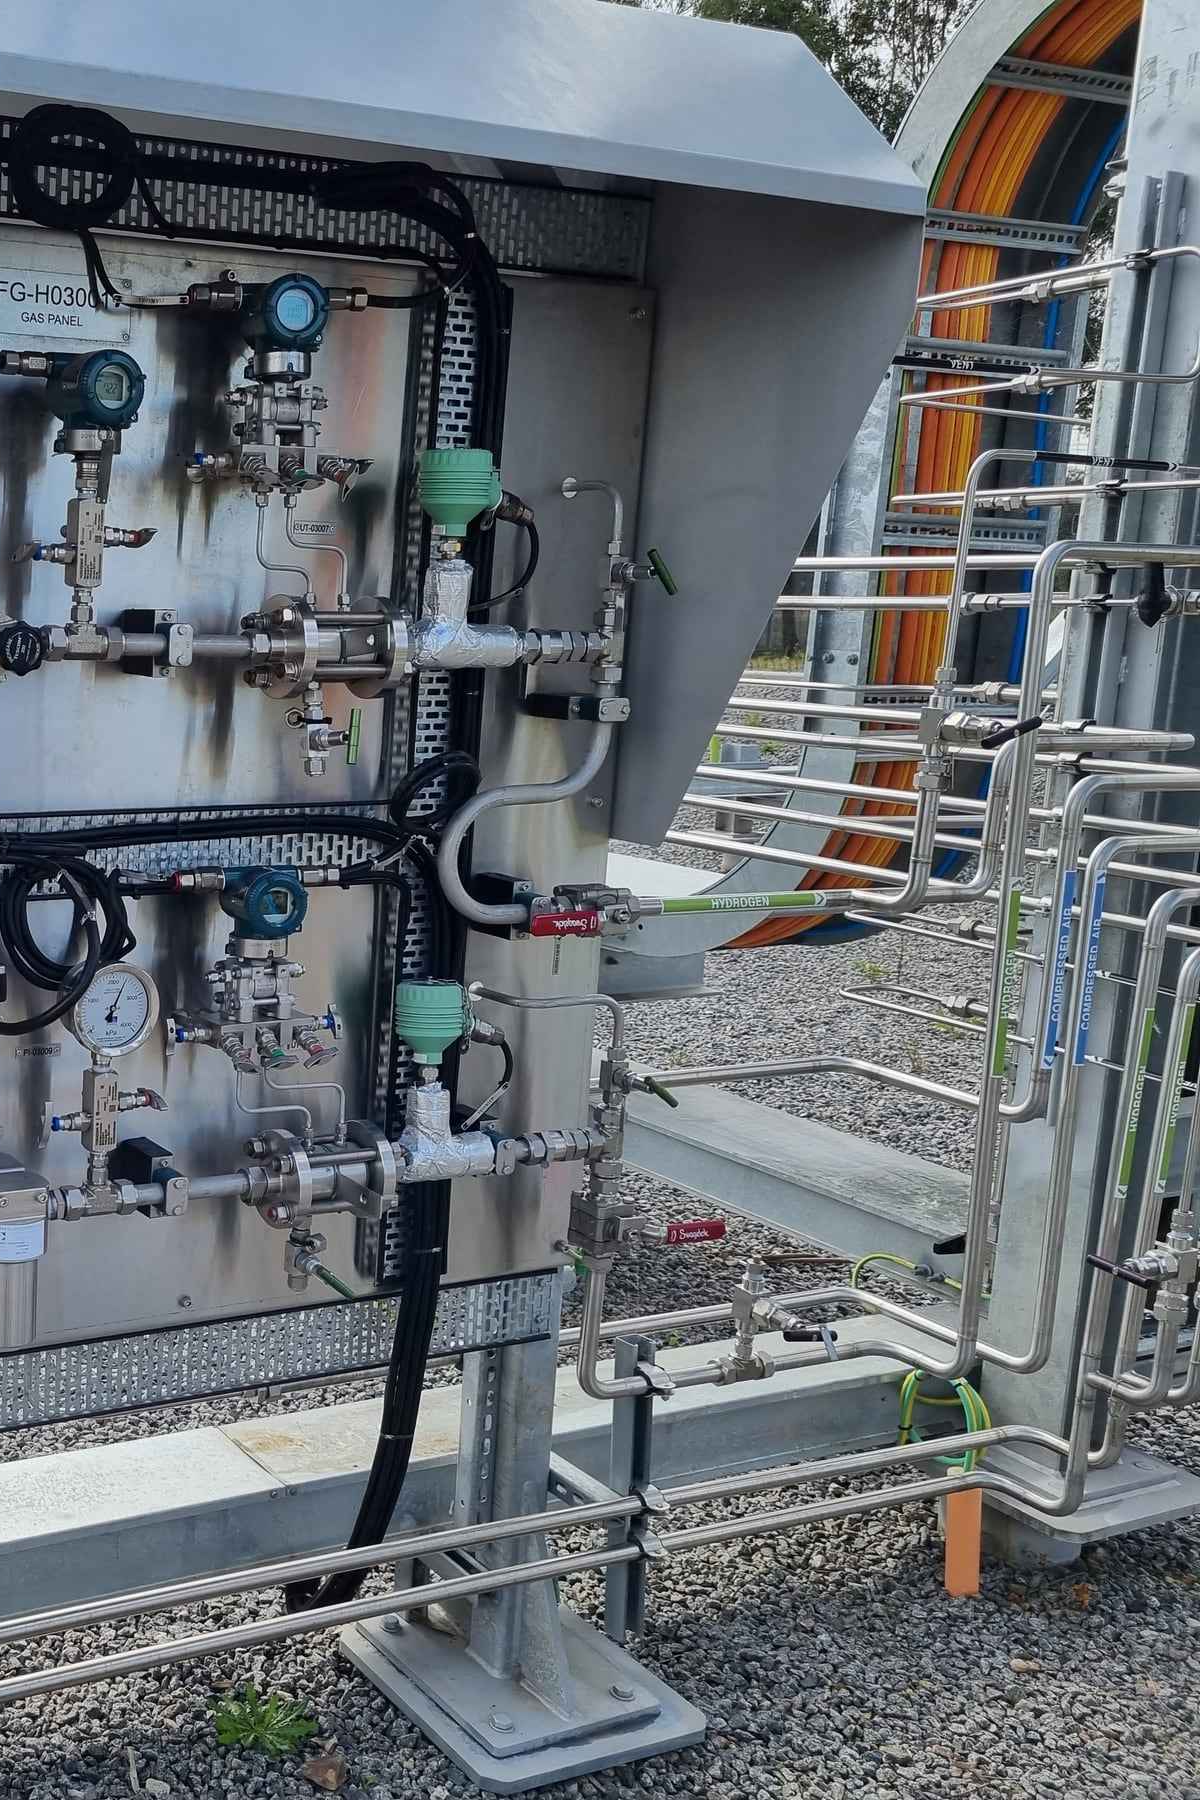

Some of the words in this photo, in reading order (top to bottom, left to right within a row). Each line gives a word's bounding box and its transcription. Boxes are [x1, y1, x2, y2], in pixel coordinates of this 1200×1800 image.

[20, 311, 45, 324] GAS
[47, 313, 84, 327] PANEL
[950, 359, 974, 370] VENT
[711, 895, 770, 910] HYDROGEN
[999, 949, 1016, 1019] HYDROGEN
[1051, 934, 1070, 1022] COMPRESSED
[1063, 907, 1073, 929] AIR
[1080, 945, 1099, 1031] COMPRESSED
[1092, 918, 1102, 939] AIR
[1128, 1065, 1146, 1132] HYDROGEN
[1169, 1061, 1187, 1127] HYDROGEN
